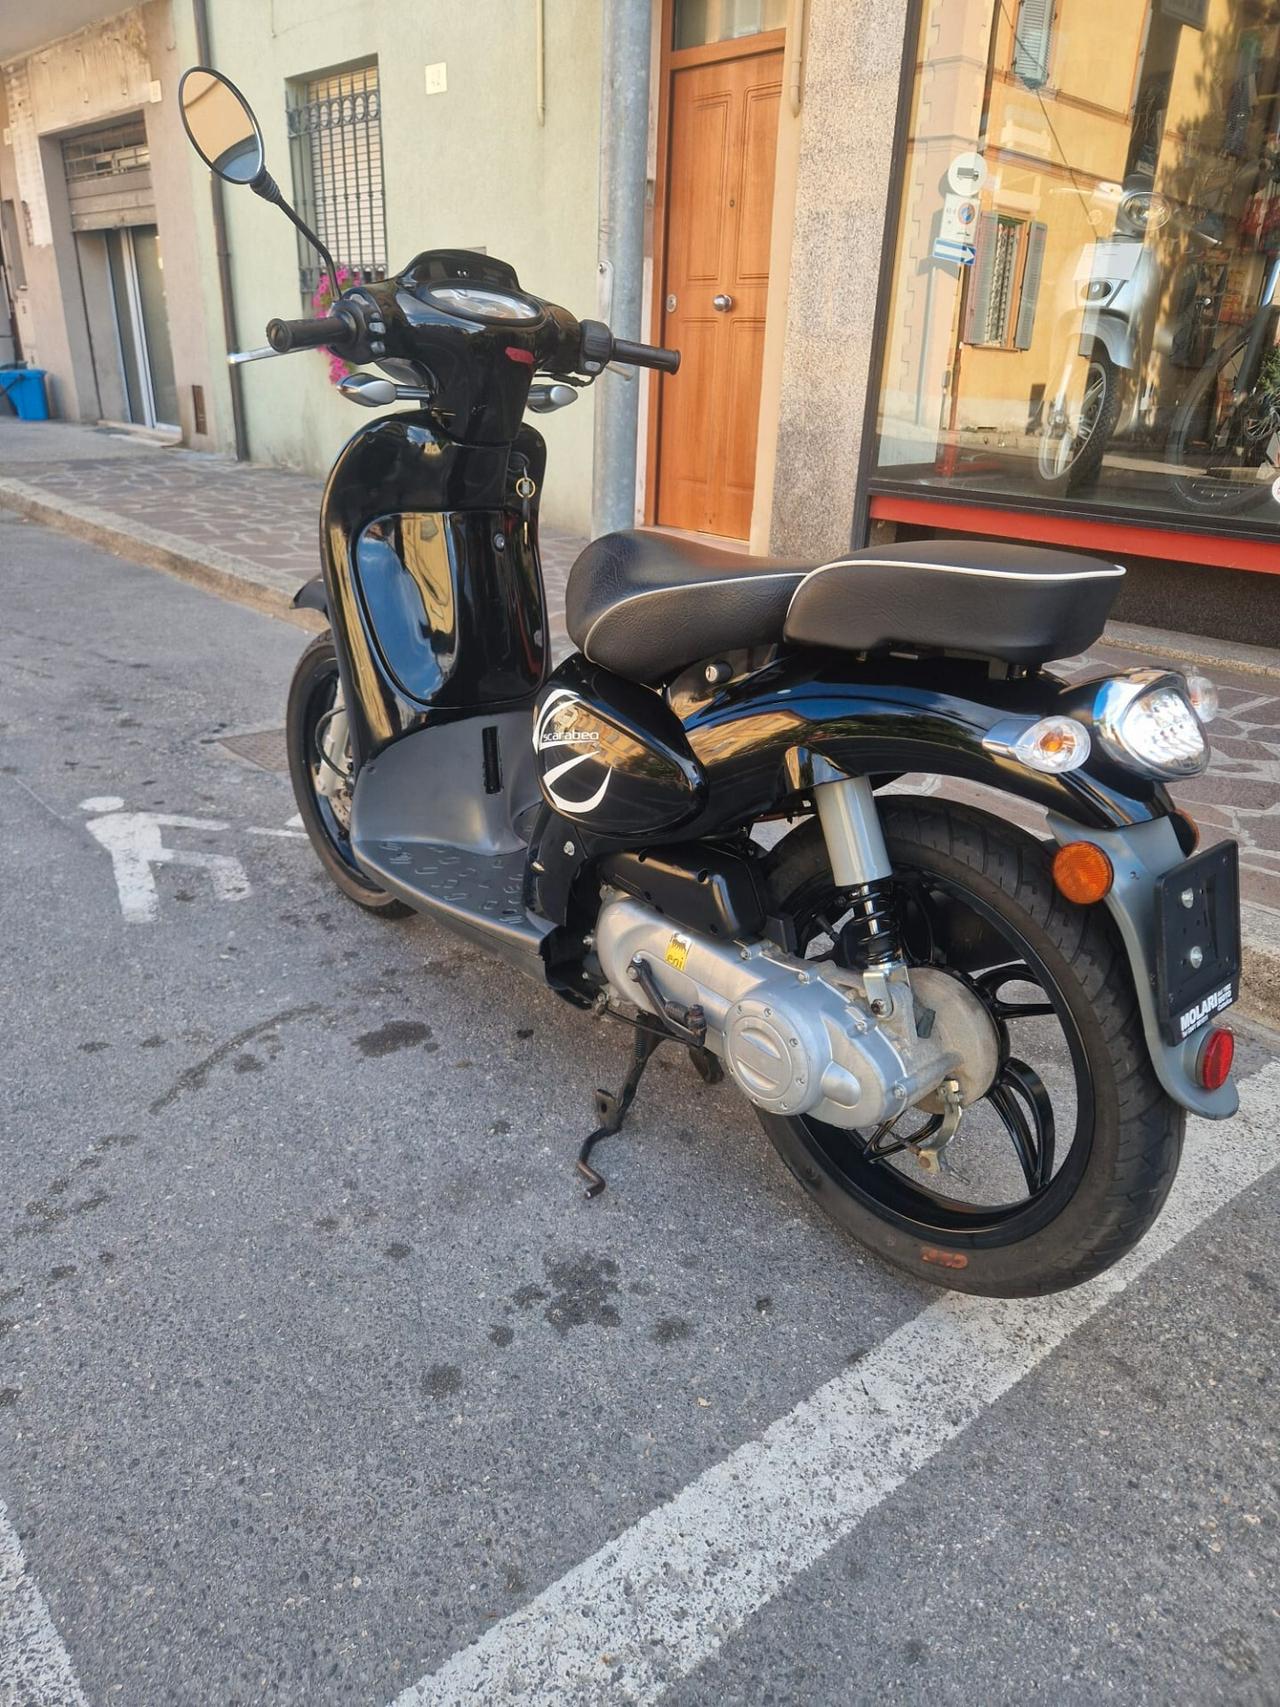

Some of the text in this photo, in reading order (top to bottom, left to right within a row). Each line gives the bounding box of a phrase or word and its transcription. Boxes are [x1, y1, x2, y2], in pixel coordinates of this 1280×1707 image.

[543, 729, 599, 742] scarabeo
[666, 954, 684, 969] eni
[1180, 992, 1218, 1031] MOLARI
